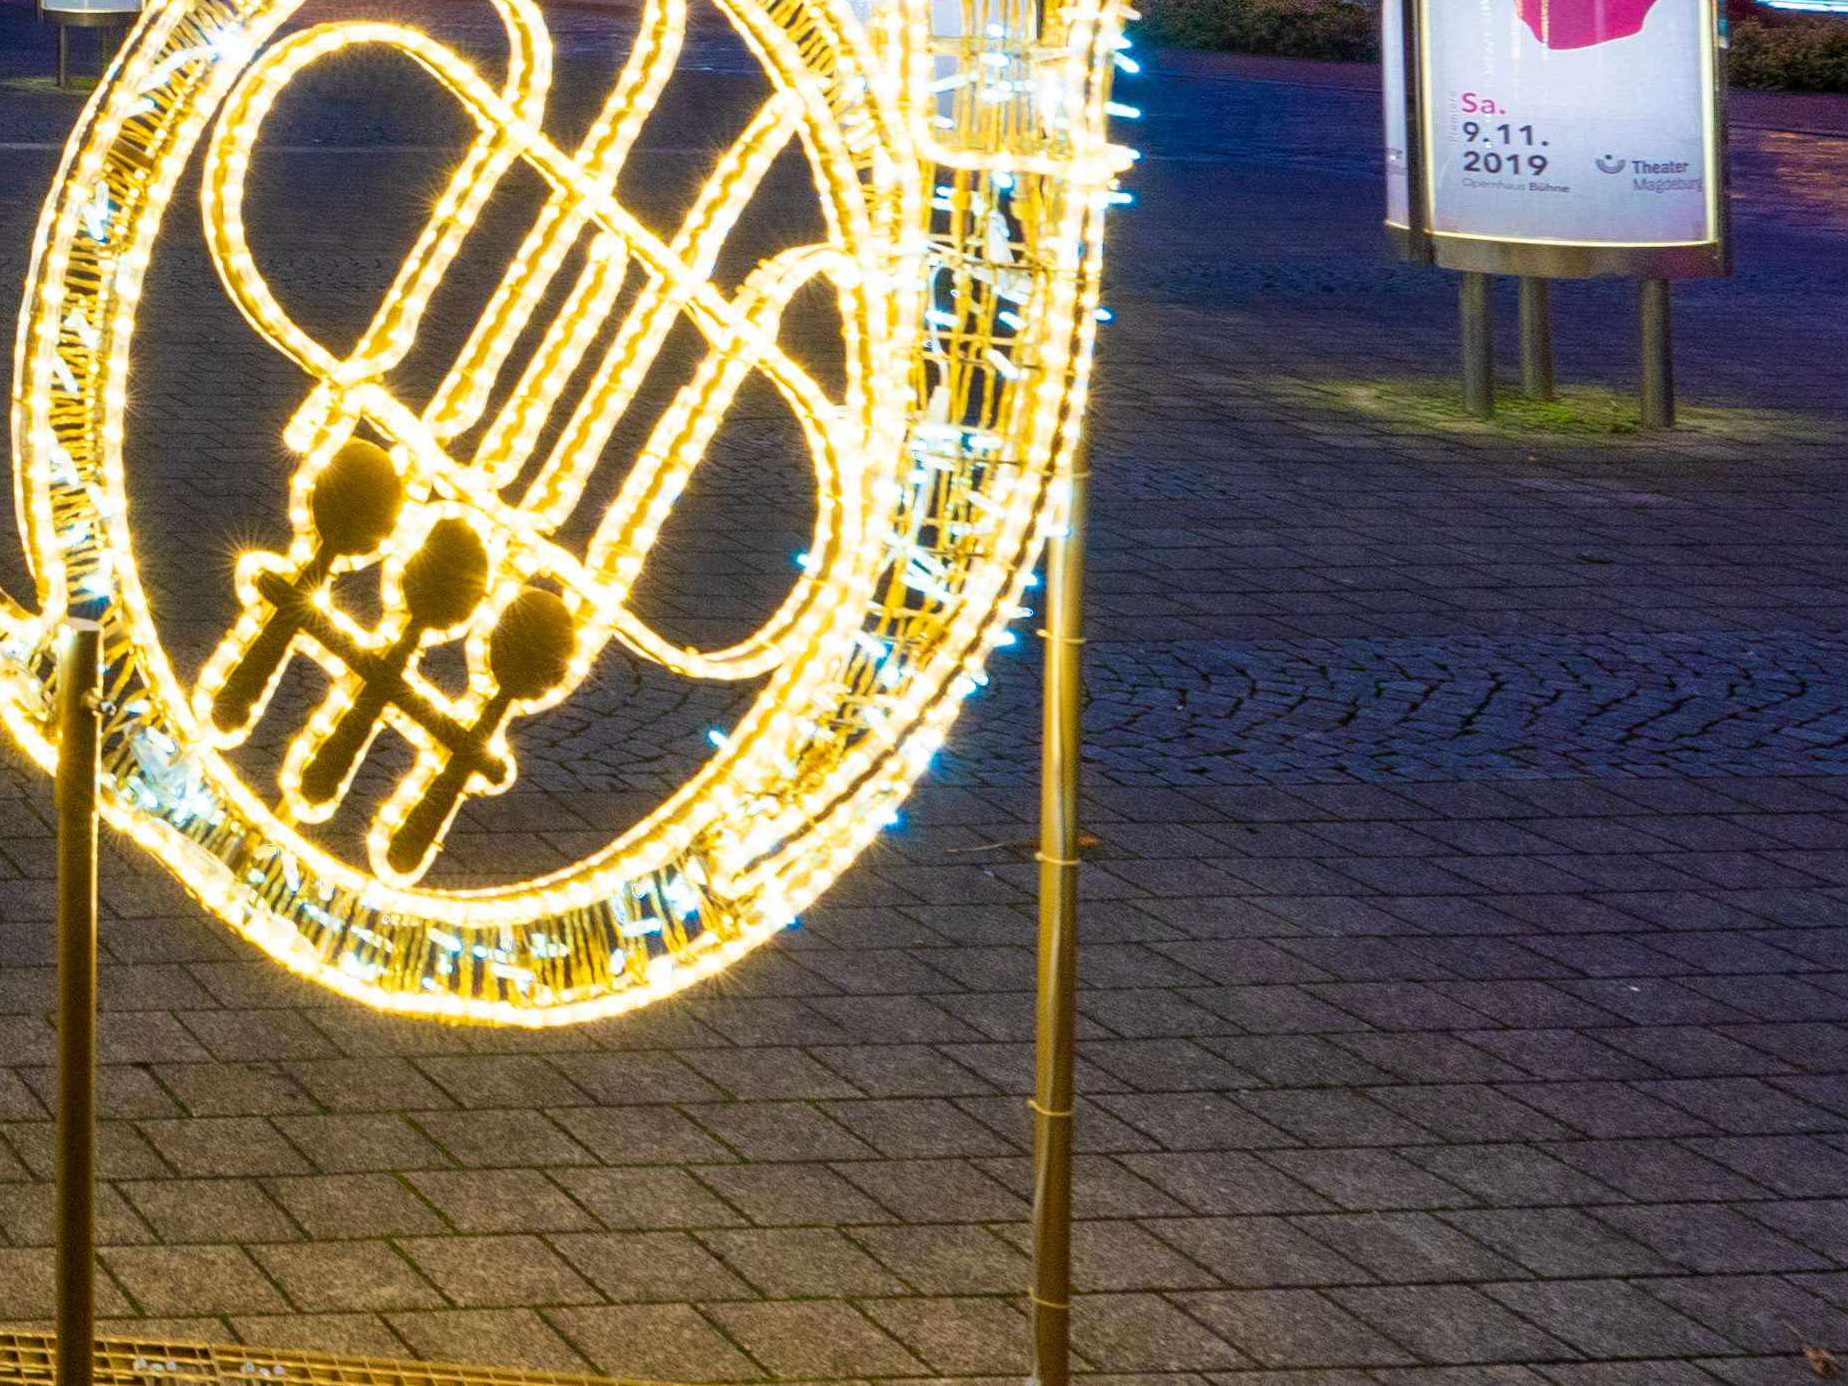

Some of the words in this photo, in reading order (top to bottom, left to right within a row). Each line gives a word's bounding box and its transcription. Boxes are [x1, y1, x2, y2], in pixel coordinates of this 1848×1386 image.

[1461, 92, 1506, 115] Sa.
[1462, 121, 1550, 147] 9.11.
[1463, 151, 1549, 176] 2019
[1631, 160, 1690, 175] Theater
[1461, 178, 1526, 192] Opernhaus
[1529, 182, 1571, 194] Bühne
[1632, 178, 1703, 194] Magdeburg
